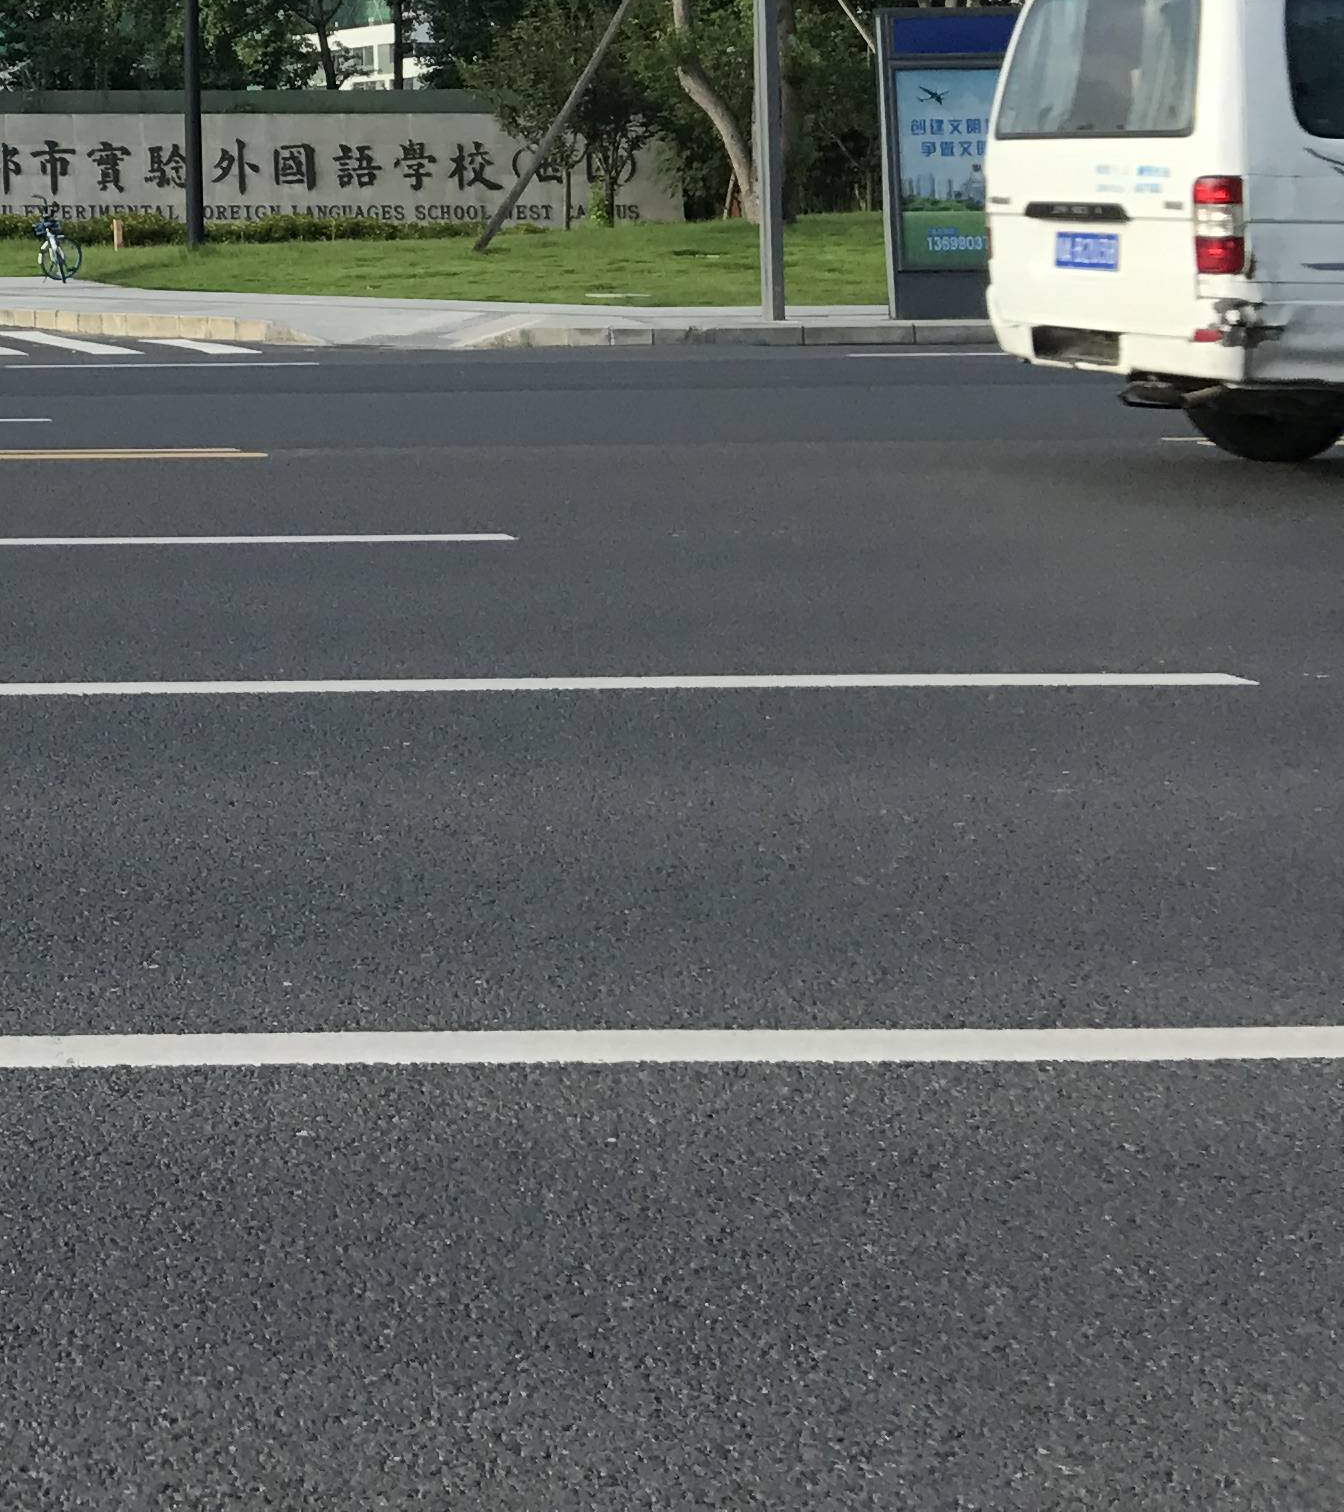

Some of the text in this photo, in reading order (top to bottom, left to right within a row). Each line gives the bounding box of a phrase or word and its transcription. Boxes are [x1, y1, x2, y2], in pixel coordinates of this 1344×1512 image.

[911, 118, 989, 136] 创建文明
[24, 204, 180, 220] EERIMENTAL
[201, 204, 281, 221] OREIGN
[415, 204, 492, 221] SCHOOL
[507, 204, 553, 221] EST
